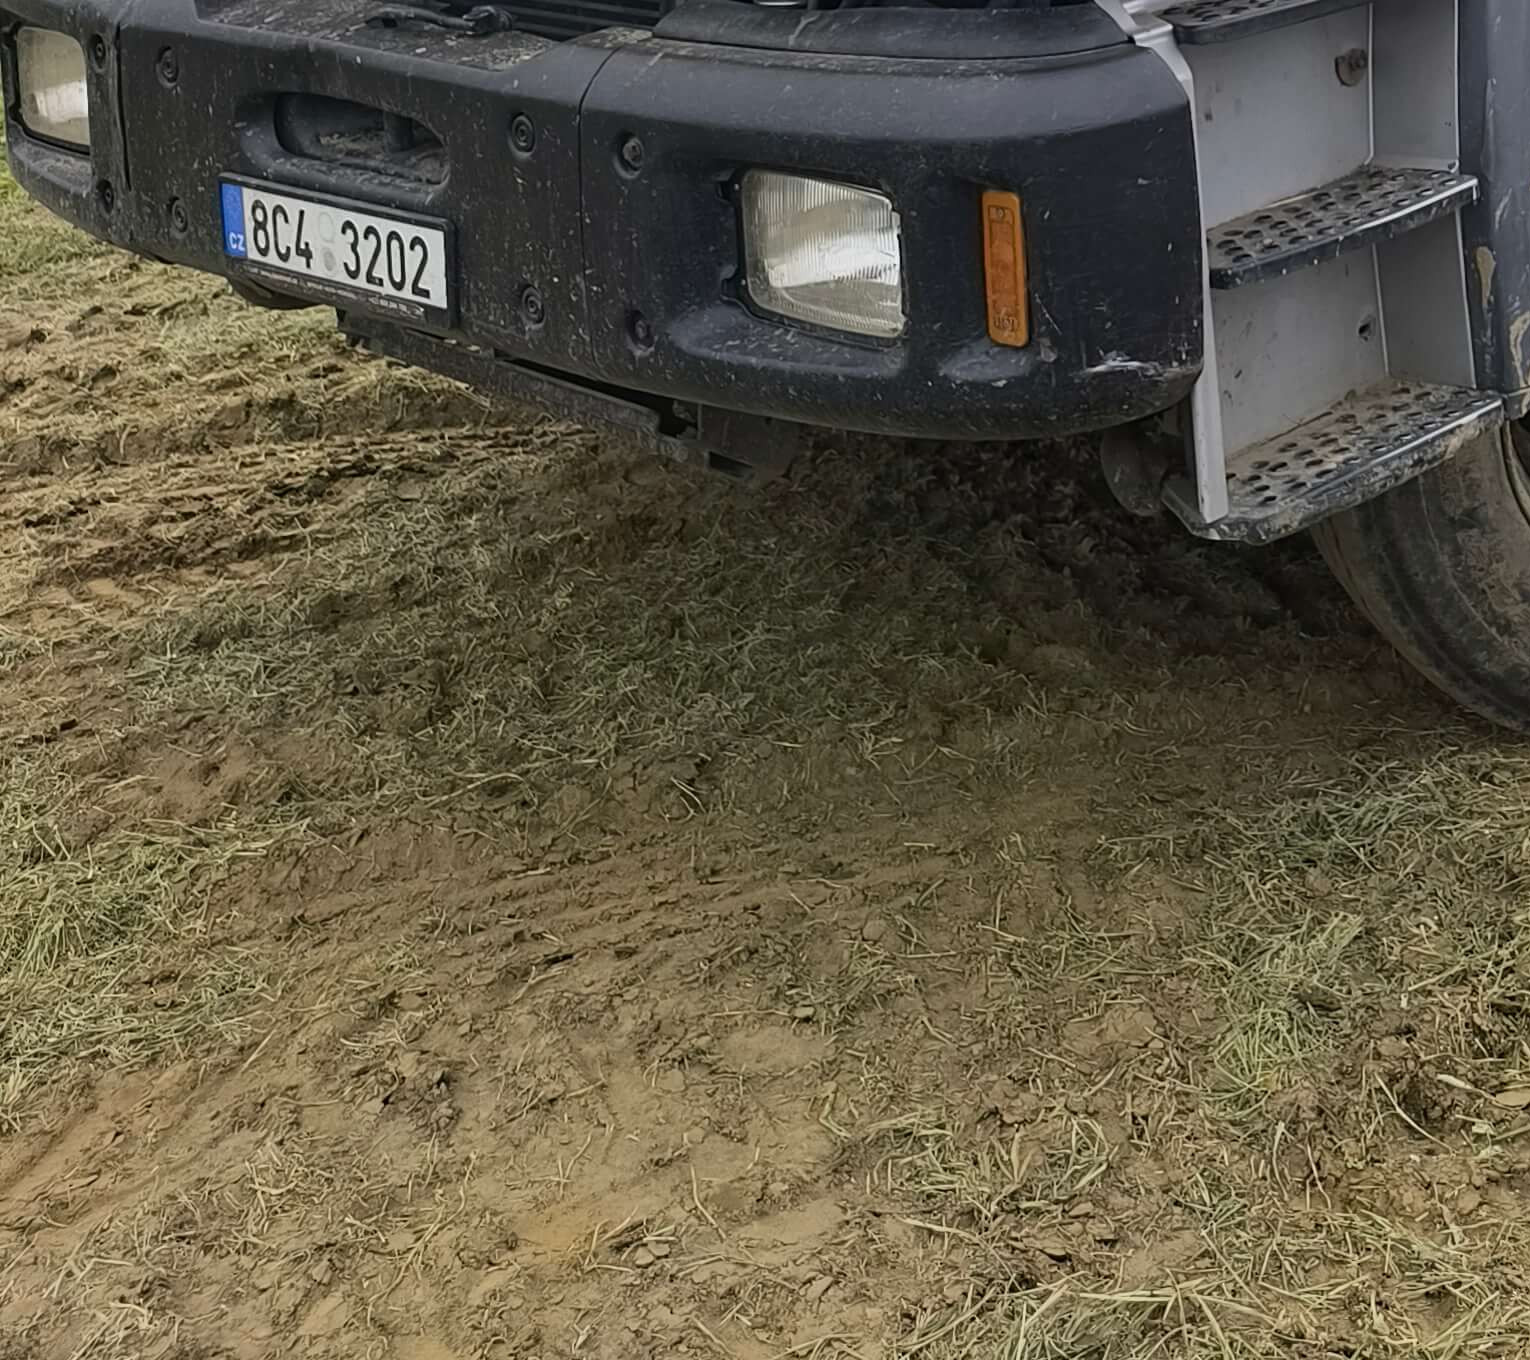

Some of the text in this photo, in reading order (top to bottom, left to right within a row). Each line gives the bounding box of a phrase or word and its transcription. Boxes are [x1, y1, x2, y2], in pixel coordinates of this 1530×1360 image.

[228, 232, 245, 251] CZ
[251, 199, 313, 269] 8C4
[341, 219, 431, 300] 3202
